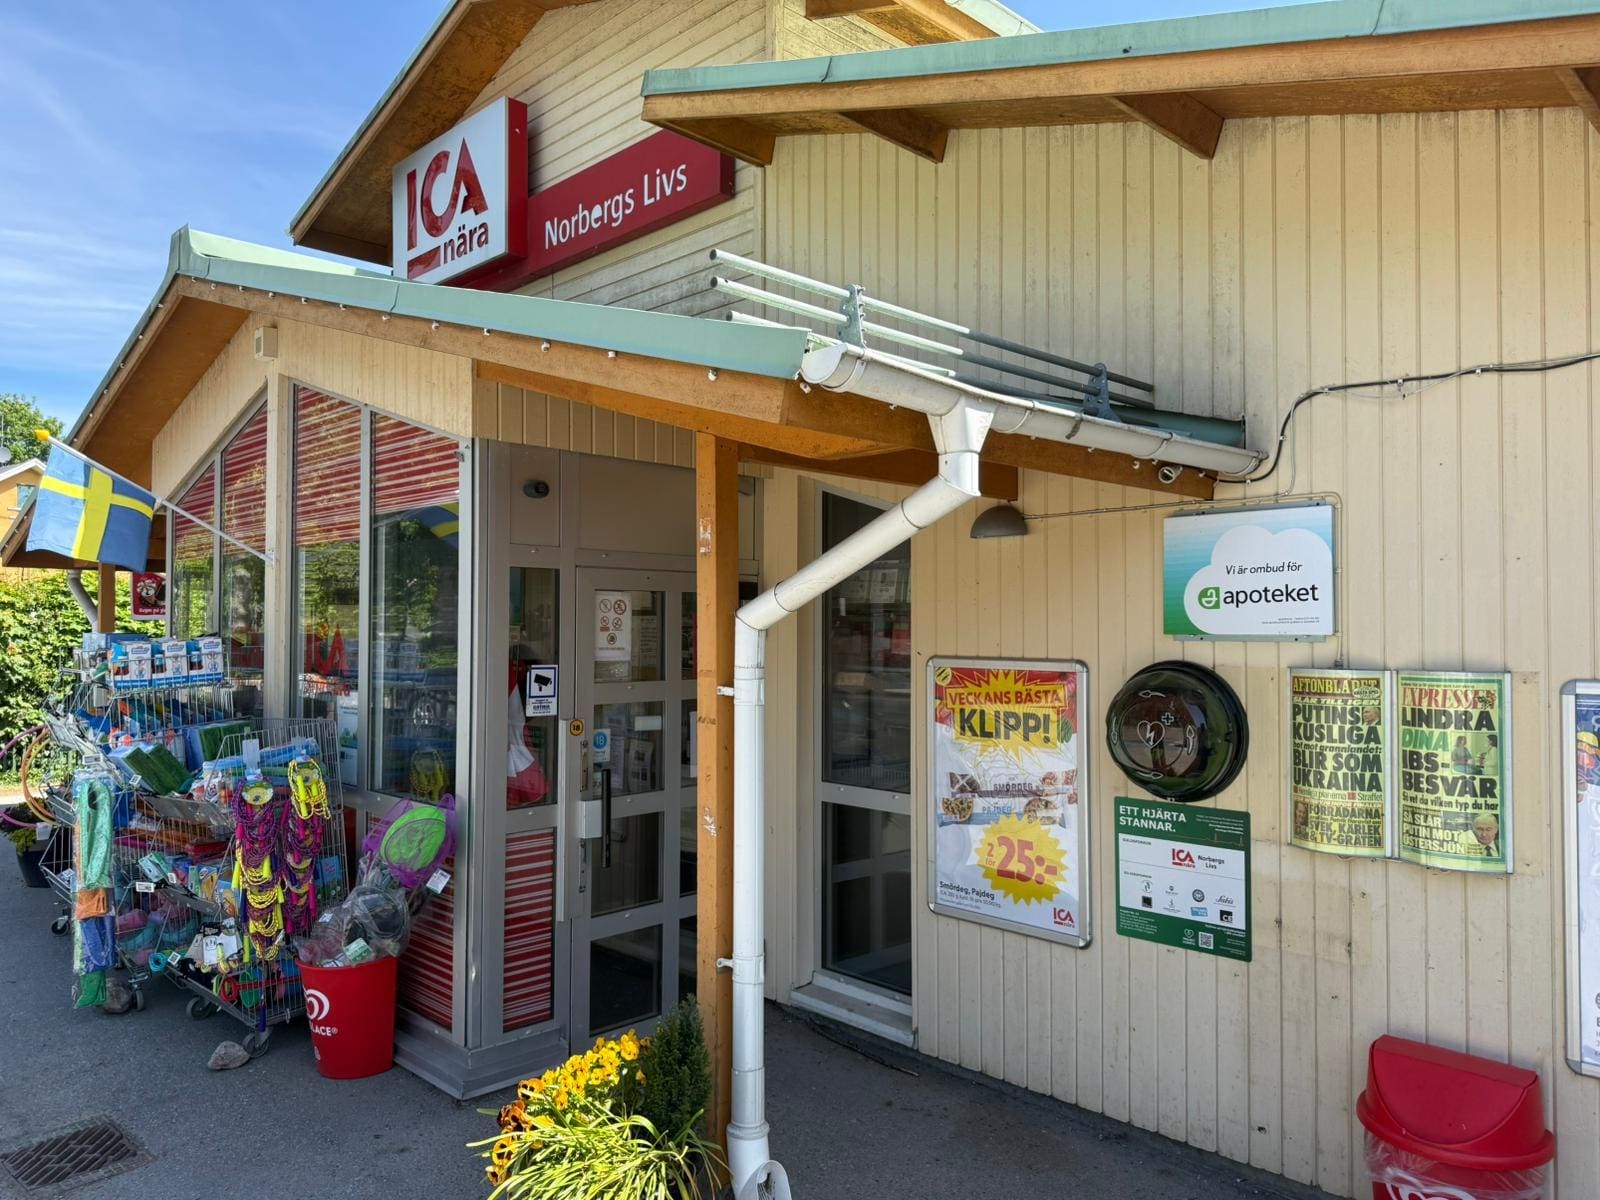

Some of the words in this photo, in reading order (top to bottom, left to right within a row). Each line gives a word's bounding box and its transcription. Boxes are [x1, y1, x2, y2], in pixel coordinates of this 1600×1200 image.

[406, 137, 489, 250] ICA
[544, 187, 635, 250] Norbergs
[643, 164, 688, 207] Livs
[443, 221, 489, 265] nära
[1225, 565, 1236, 575] Vi
[1237, 564, 1248, 575] är
[1250, 562, 1285, 575] ombud
[1287, 560, 1303, 573] för
[1223, 584, 1320, 608] apoteket
[949, 691, 1013, 706] VECKANS
[1015, 689, 1063, 705] BÄSTA
[1320, 697, 1344, 706] TILL
[1348, 698, 1380, 706] IGEN
[1402, 687, 1497, 709] EXPRESSEN
[1293, 703, 1361, 725] PUTINS
[1402, 707, 1496, 731] LINDRA
[959, 708, 1051, 744] KLIPP!
[1293, 722, 1381, 745] KUSLIGA
[1304, 742, 1320, 751] mot
[1402, 727, 1450, 752] DINA
[1293, 749, 1328, 770] BLIR
[1332, 753, 1382, 773] SOM
[1402, 749, 1450, 773] IBS-
[1294, 768, 1382, 791] UKRAINA
[1402, 771, 1498, 799] BESVÄR
[1358, 791, 1383, 801] Straffet
[1431, 797, 1453, 808] vilken
[1456, 800, 1470, 811] typ
[1472, 800, 1482, 810] du
[1484, 800, 1498, 810] har
[1119, 805, 1139, 817] ETT
[1142, 806, 1187, 823] HJÄRTA
[1119, 817, 1176, 832] STANNAR.
[1403, 822, 1430, 839] PUTIN
[1432, 828, 1460, 841] MOT
[987, 843, 994, 858] 2
[1172, 848, 1195, 864] ICA
[1198, 854, 1225, 865] Norbergs
[985, 856, 996, 867] för
[996, 836, 1058, 885] 25:-
[1205, 862, 1217, 870] Livs
[939, 881, 971, 896] Smördeg,
[971, 888, 995, 900] Pajdeg
[1053, 907, 1075, 923] ICA
